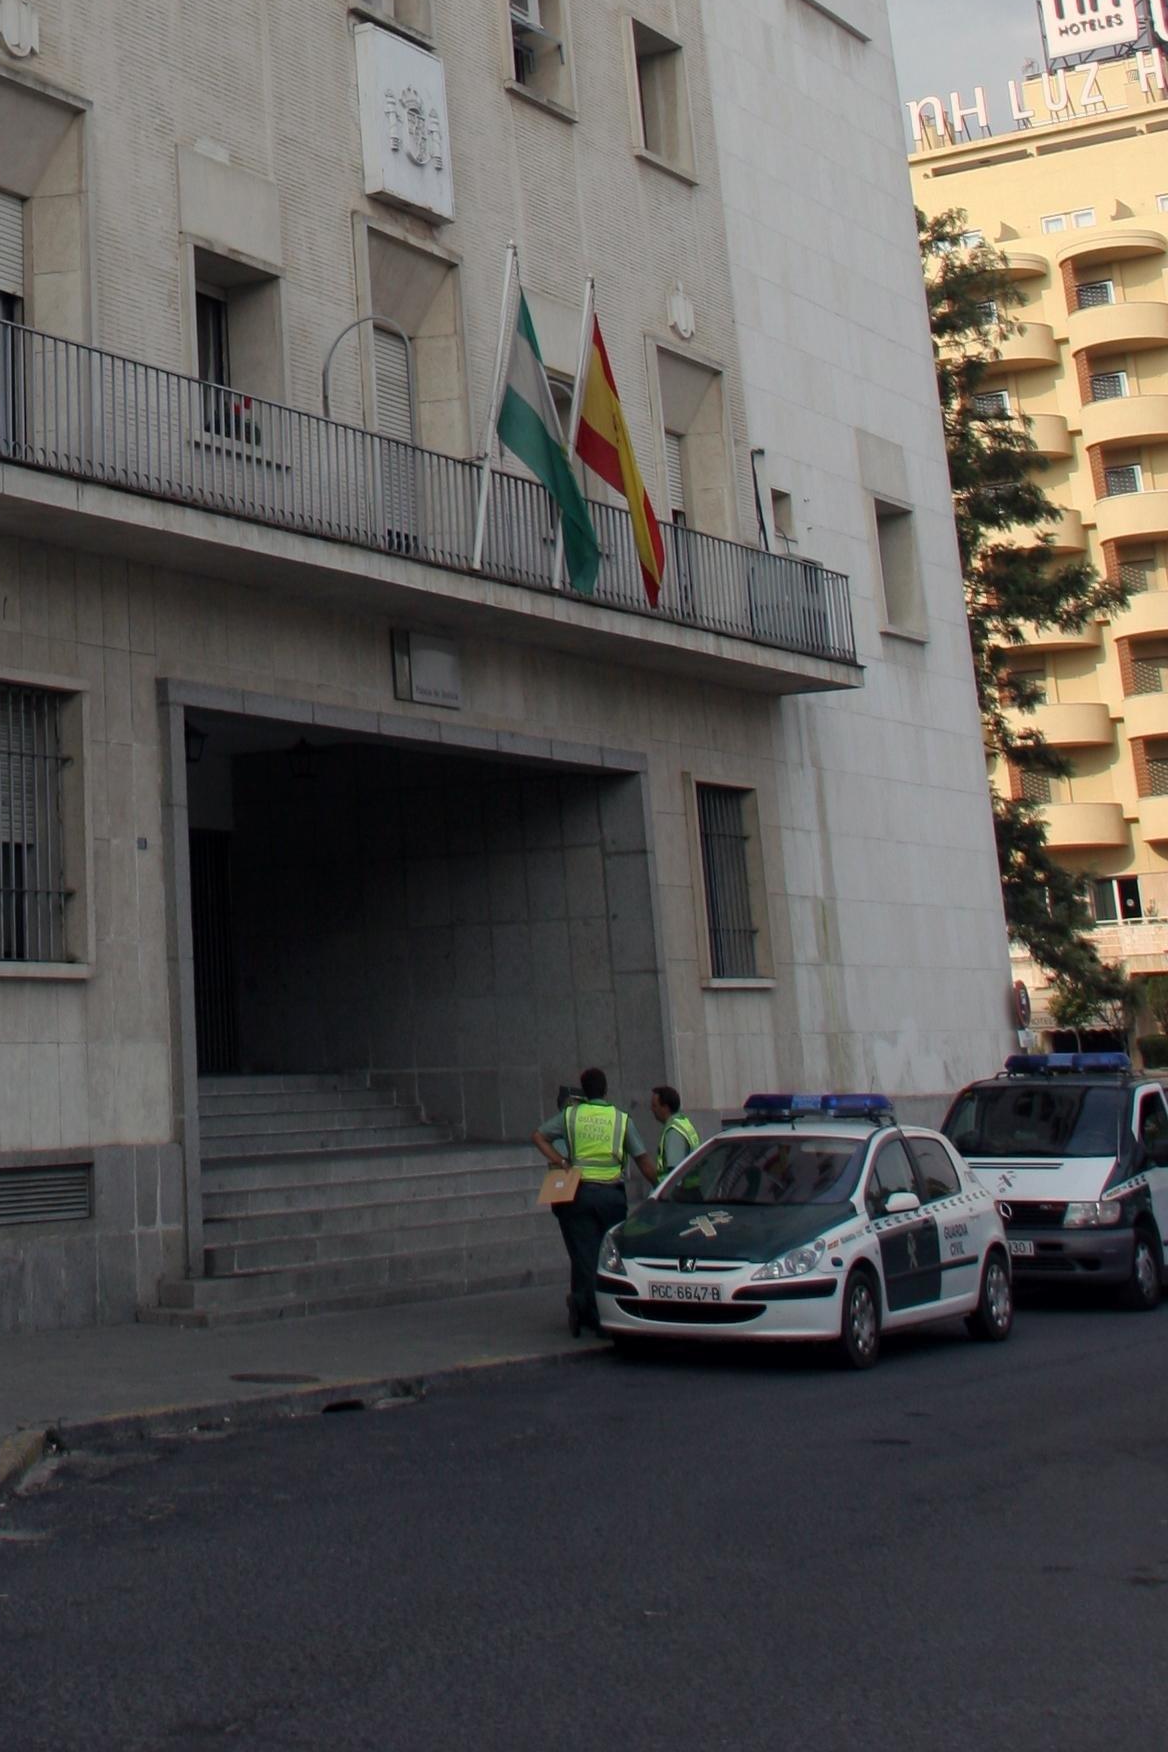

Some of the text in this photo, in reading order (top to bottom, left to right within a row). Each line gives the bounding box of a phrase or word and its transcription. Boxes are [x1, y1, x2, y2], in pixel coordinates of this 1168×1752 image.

[1058, 13, 1124, 37] HOTELES
[1008, 62, 1104, 120] LUZ
[578, 1116, 612, 1127] GUARDIA
[583, 1124, 606, 1134] CIVIL
[943, 1223, 969, 1241] GUARDIA
